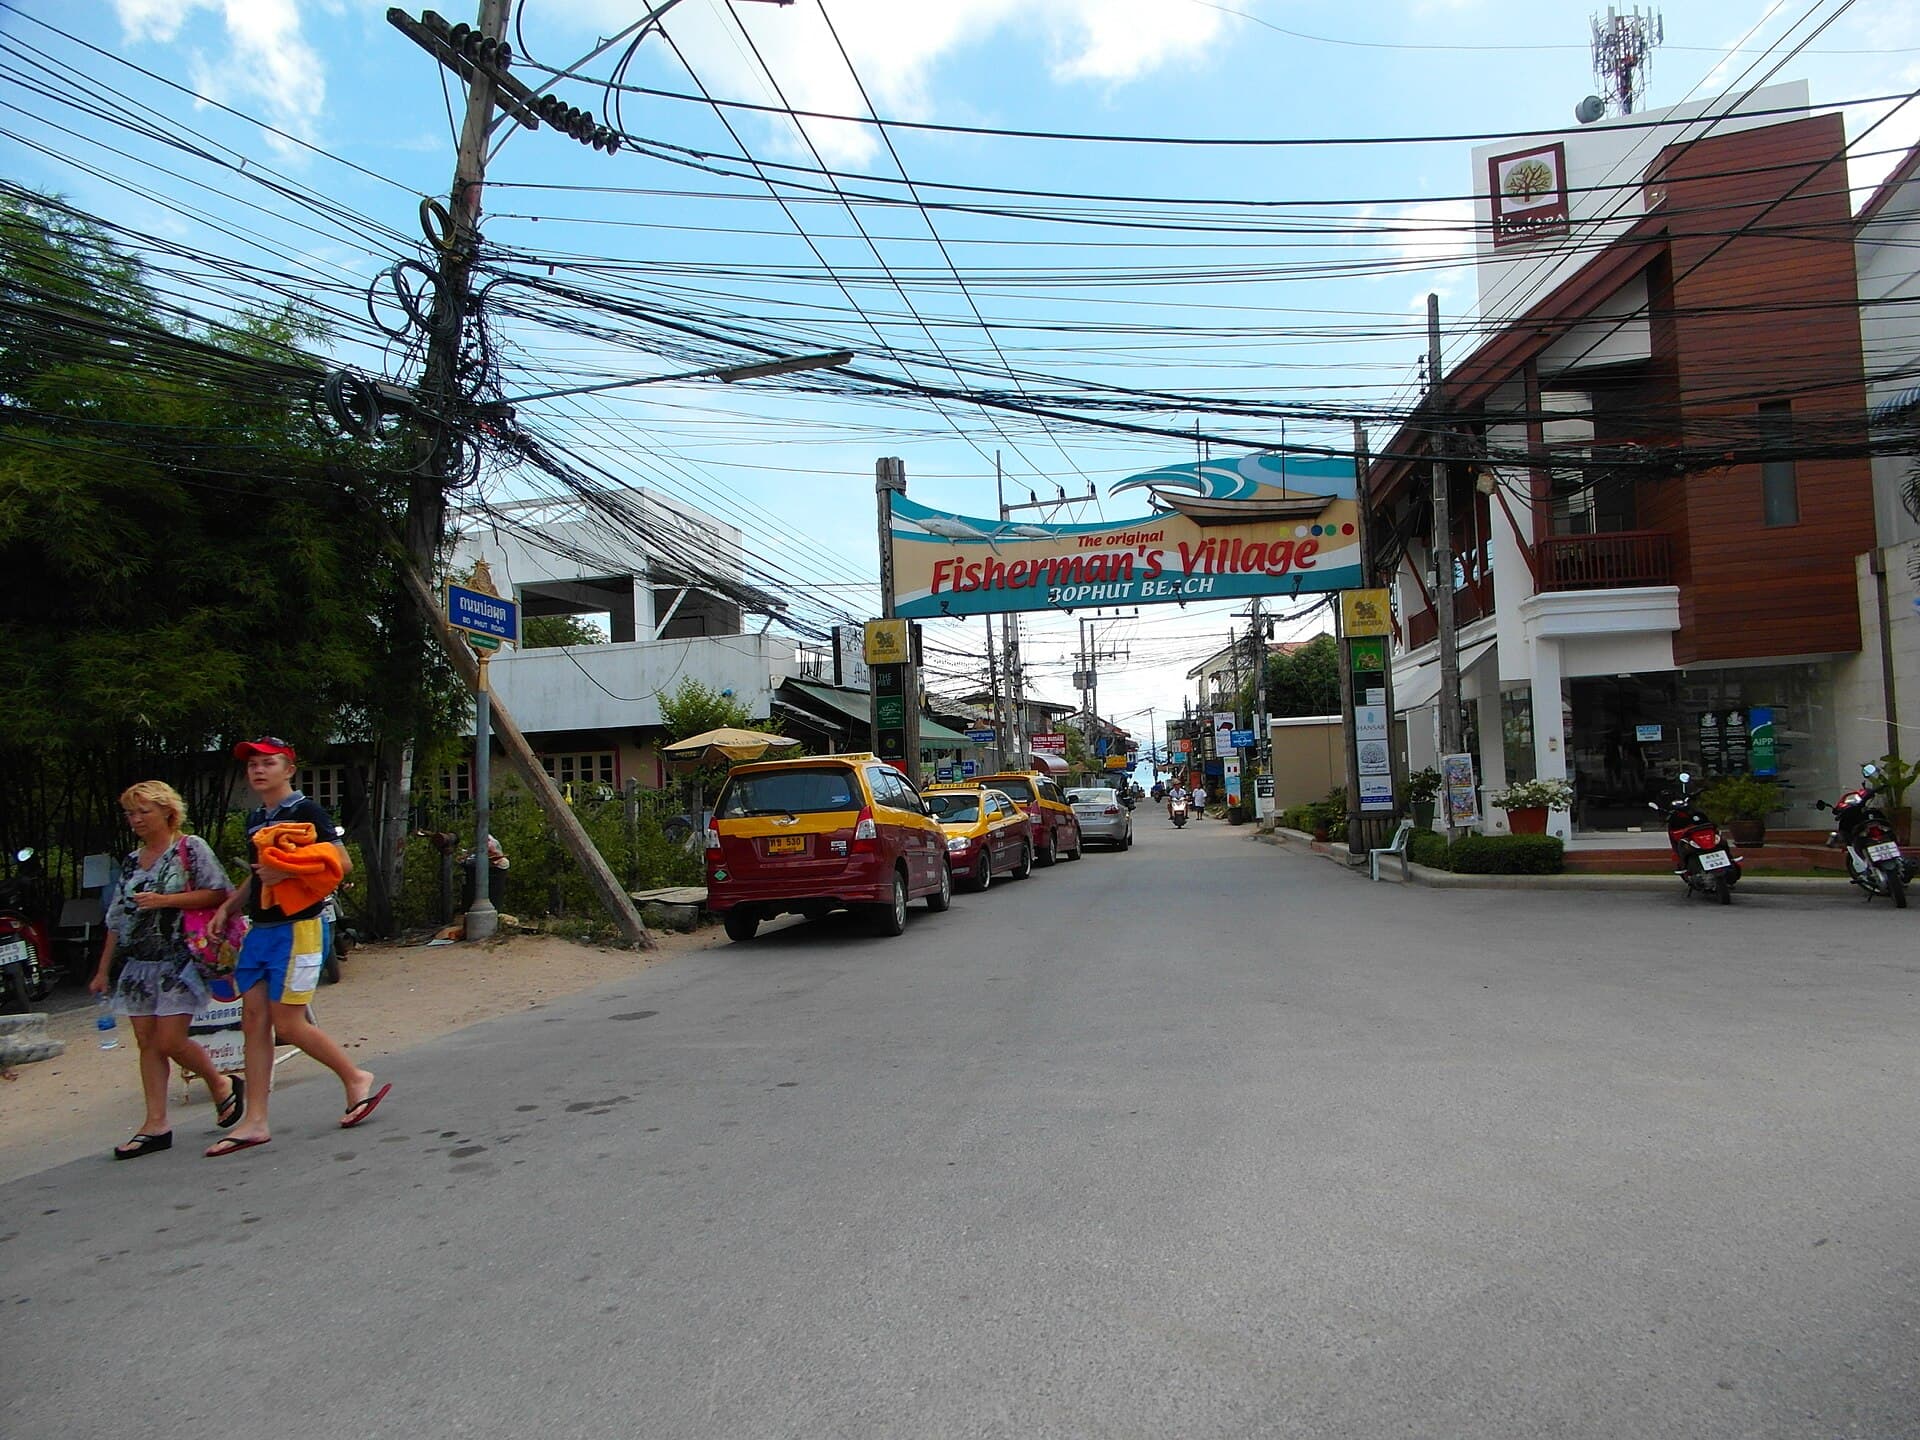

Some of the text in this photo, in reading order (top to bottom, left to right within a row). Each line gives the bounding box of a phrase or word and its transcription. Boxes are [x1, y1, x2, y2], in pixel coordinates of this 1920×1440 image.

[1077, 530, 1164, 548] The original
[931, 537, 1320, 595] Fisherman's Village
[459, 596, 507, 625] ถนนบ่อผุด
[462, 616, 505, 633] BO PHUT ROAD
[878, 672, 892, 680] THE
[1753, 737, 1774, 746] AIPP
[787, 838, 801, 847] 530
